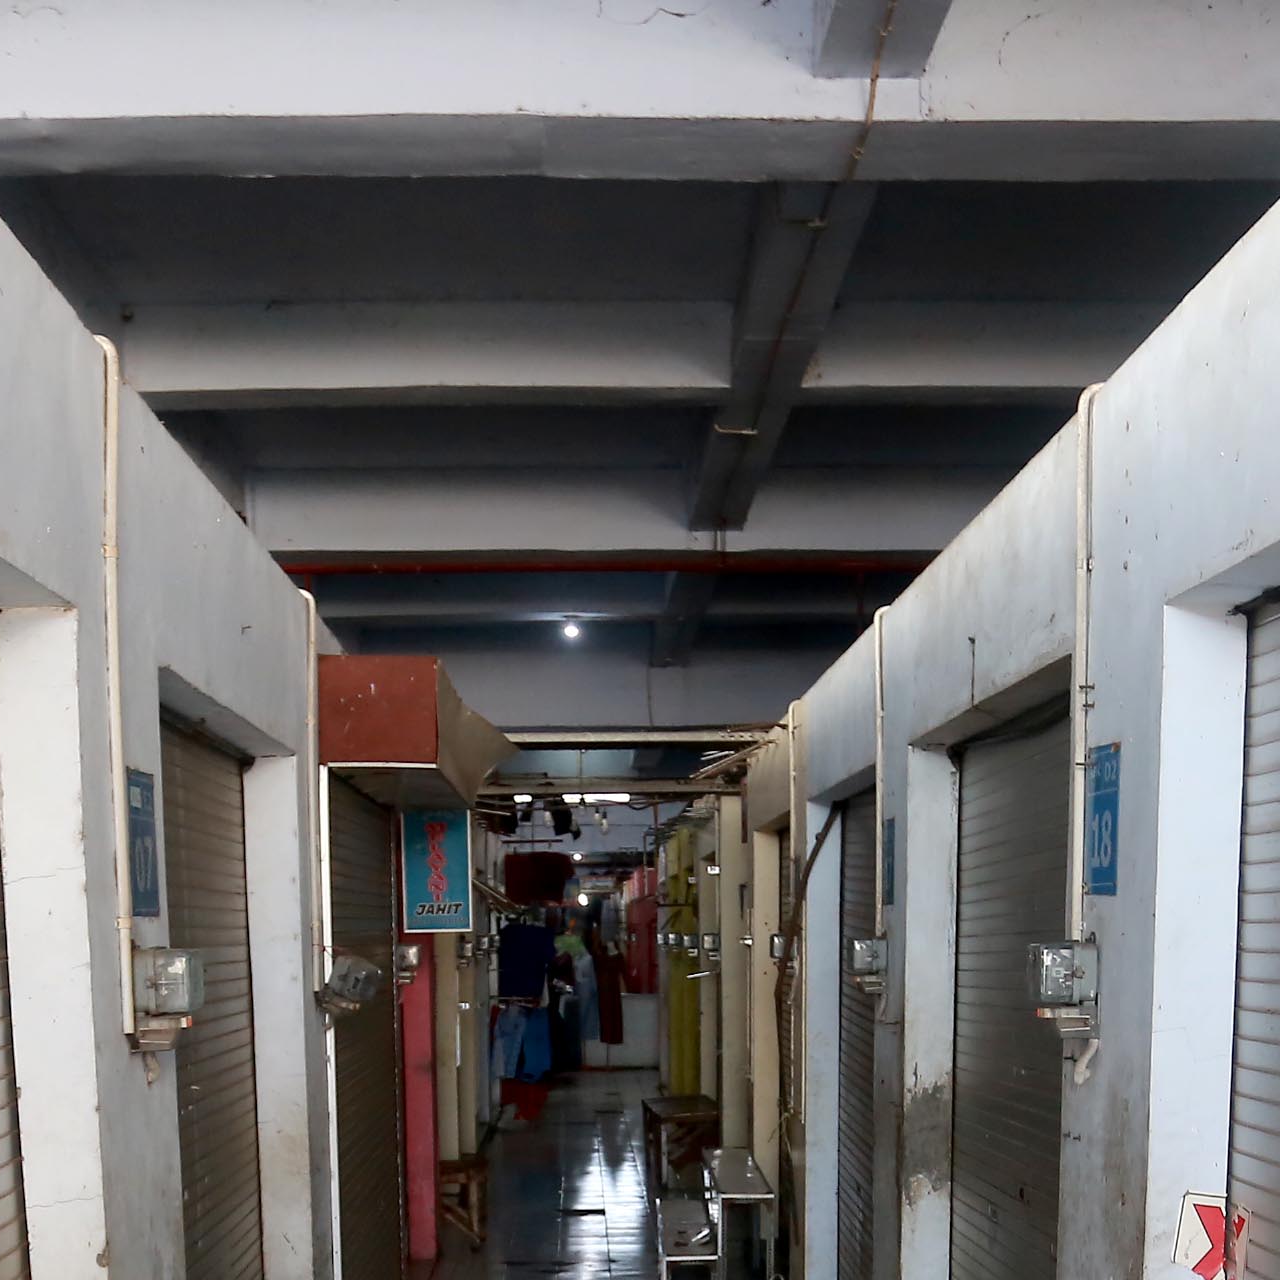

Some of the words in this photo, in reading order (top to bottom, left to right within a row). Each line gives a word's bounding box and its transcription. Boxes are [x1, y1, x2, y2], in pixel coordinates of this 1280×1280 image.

[135, 835, 153, 892] 07
[1090, 810, 1113, 868] 18
[416, 902, 463, 916] JAHIT
